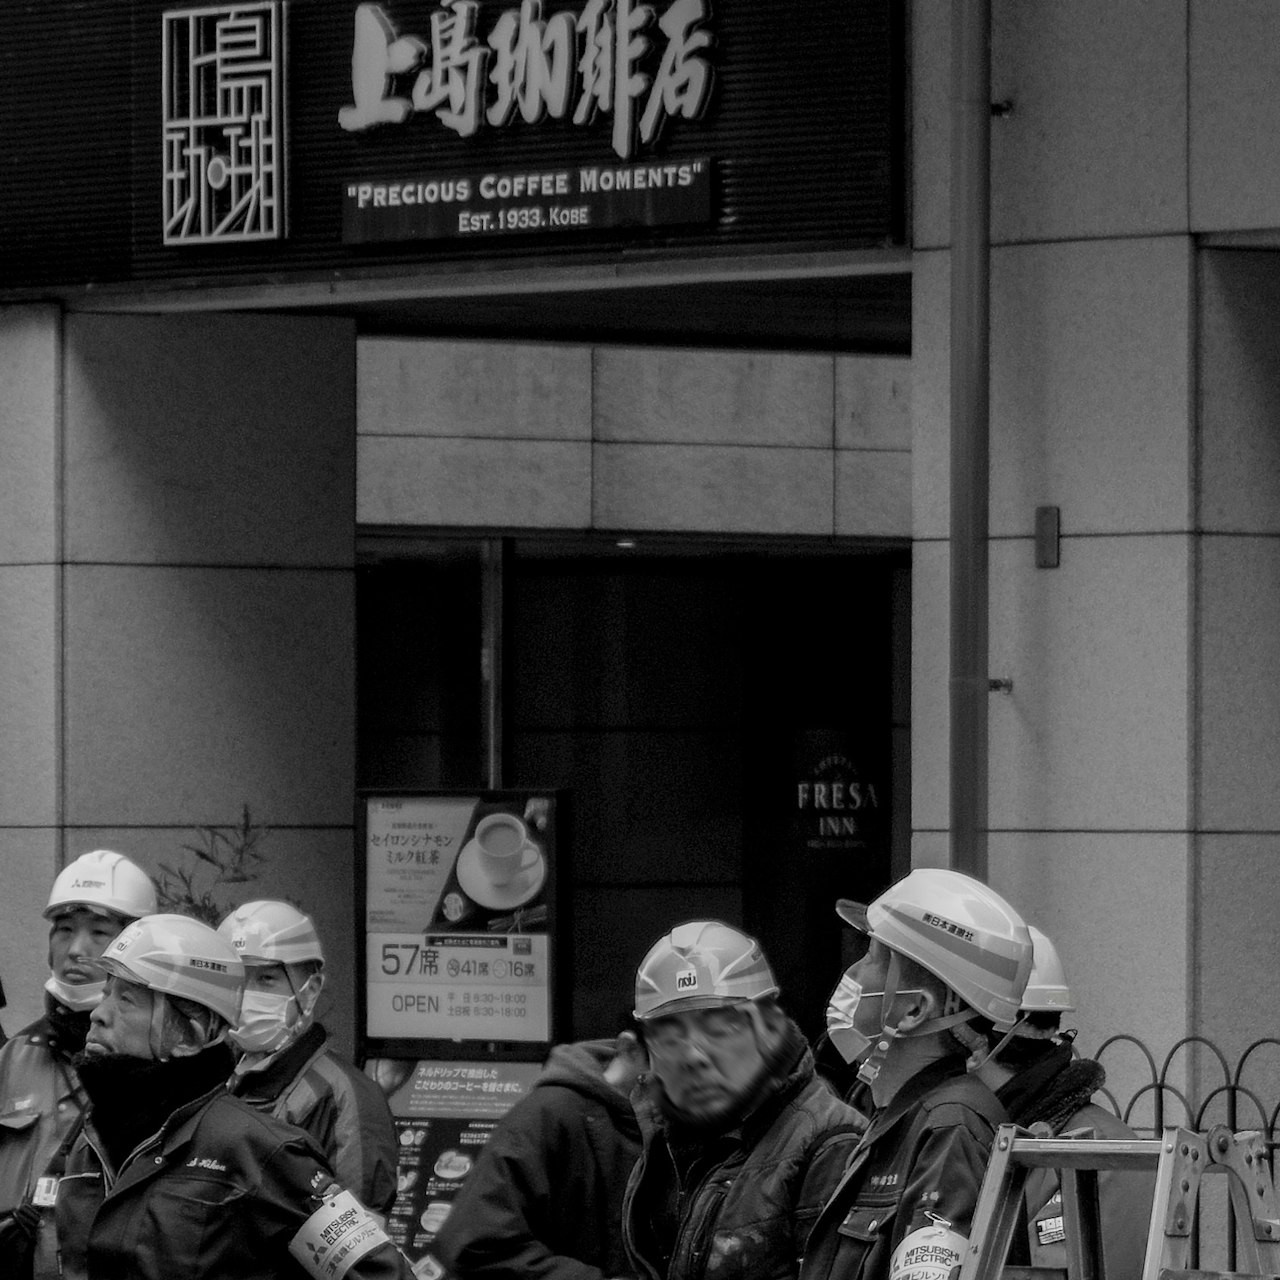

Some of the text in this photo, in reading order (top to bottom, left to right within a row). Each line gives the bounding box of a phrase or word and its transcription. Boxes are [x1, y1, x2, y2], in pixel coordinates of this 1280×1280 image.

[479, 172, 568, 202] COFFEE
[819, 816, 855, 837] INN
[381, 944, 440, 977] 57席
[392, 994, 440, 1013] OPEN
[903, 1254, 953, 1267] ELECTRIC
[905, 1245, 960, 1262] MITSUBISHI
